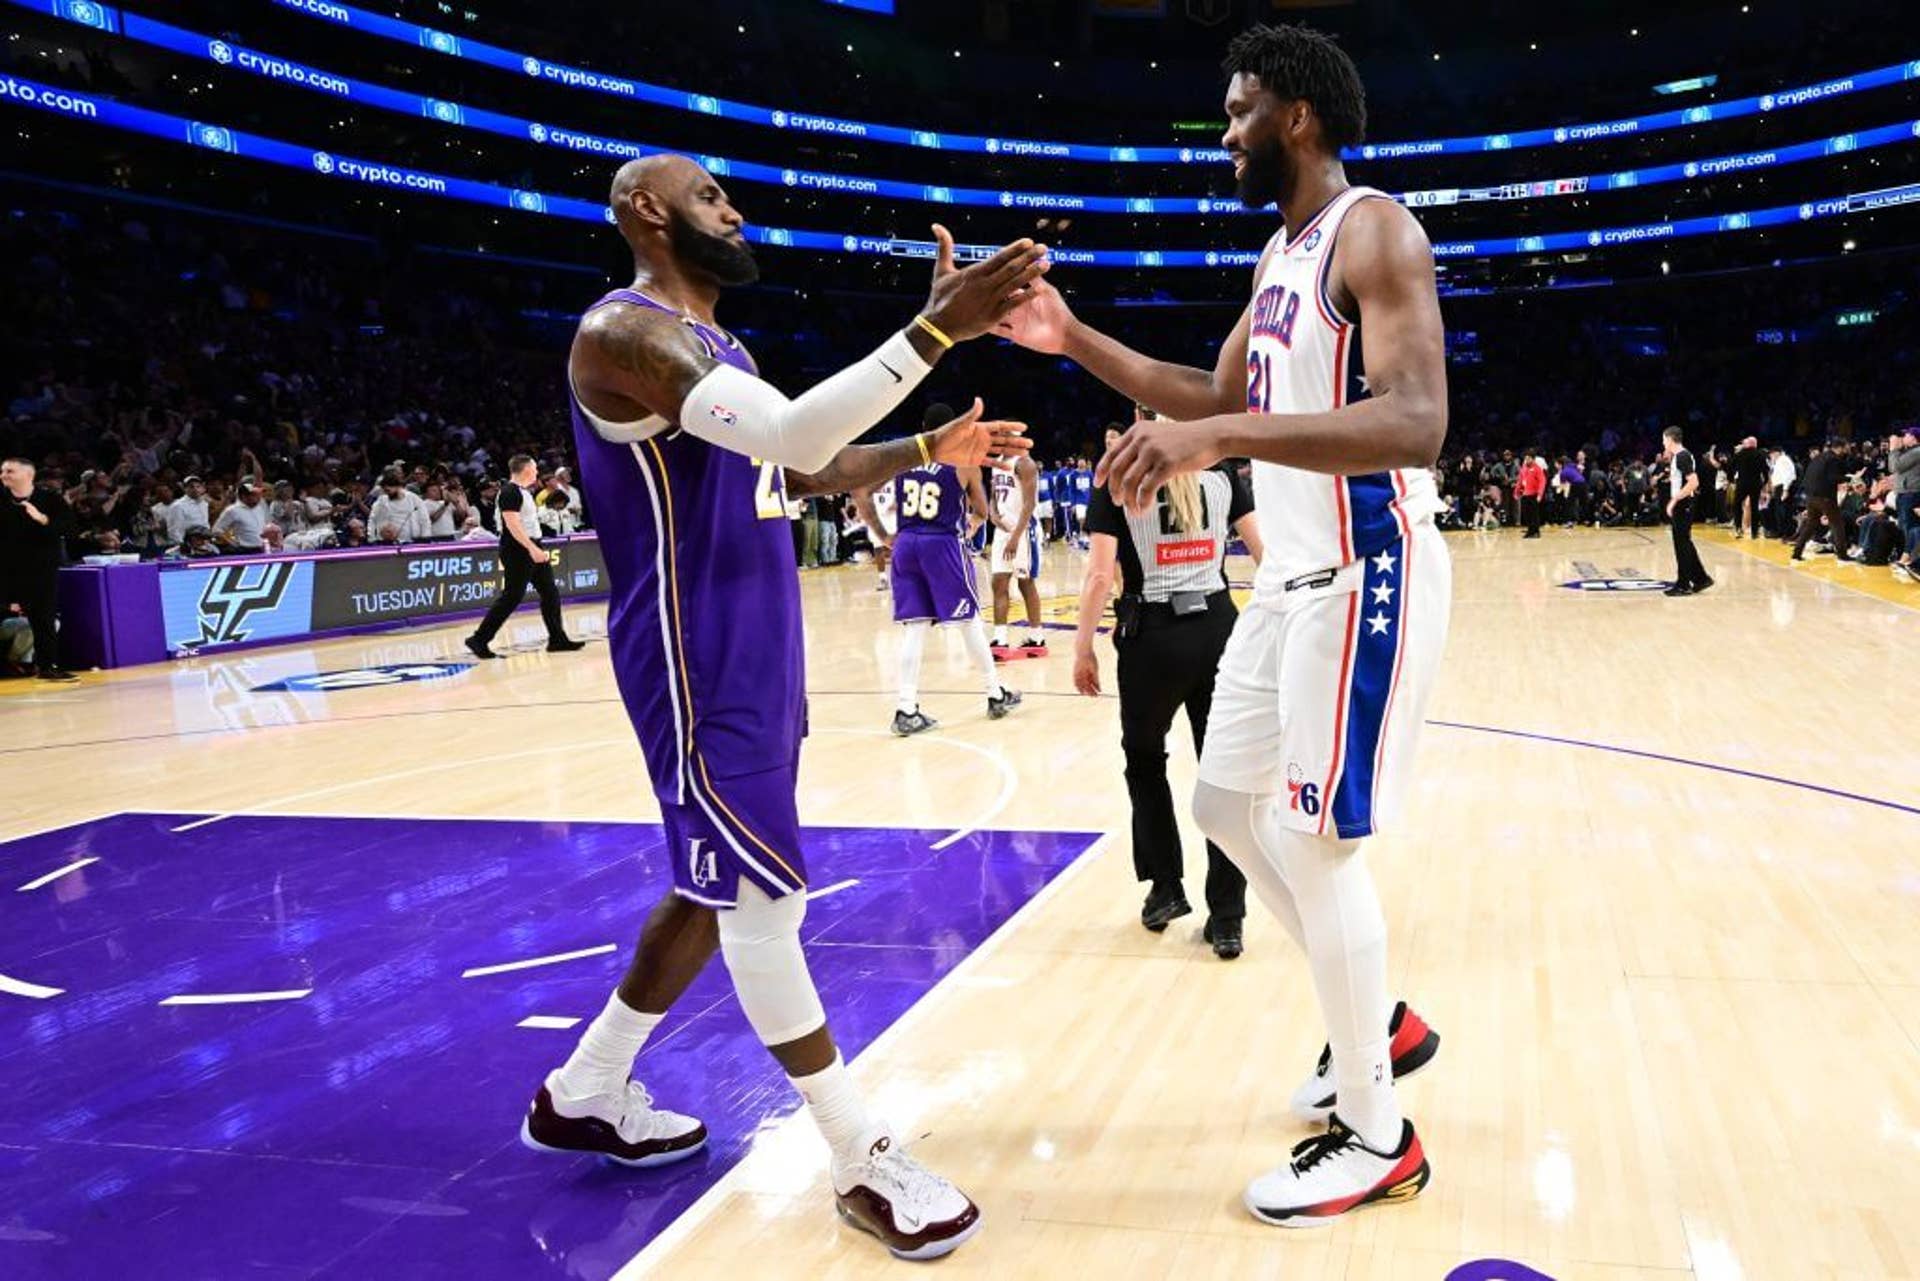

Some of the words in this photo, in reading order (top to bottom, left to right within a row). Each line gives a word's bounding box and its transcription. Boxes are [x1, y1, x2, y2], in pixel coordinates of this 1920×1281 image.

[285, 0, 349, 22] o.com
[238, 51, 349, 95] crypto.com
[544, 65, 635, 95] crypto.com
[1776, 79, 1853, 106] crypto.com
[790, 115, 866, 136] crypto.com
[1570, 120, 1638, 139] crypto.com
[550, 130, 640, 158] crypto.com
[1002, 142, 1069, 156] crypto.com
[1378, 143, 1443, 157] crypto.com
[1701, 153, 1776, 173] crypto.com
[338, 160, 446, 193] crypto.com
[801, 175, 877, 193] crypto.com
[1016, 195, 1083, 209] crypto.com
[1604, 224, 1673, 243] crypto.com
[1247, 350, 1270, 416] 21
[902, 478, 941, 519] 36
[1161, 546, 1211, 560] Emirates
[407, 556, 472, 581] SPURS
[351, 585, 437, 615] TUESDAY
[448, 581, 484, 602] 7:30
